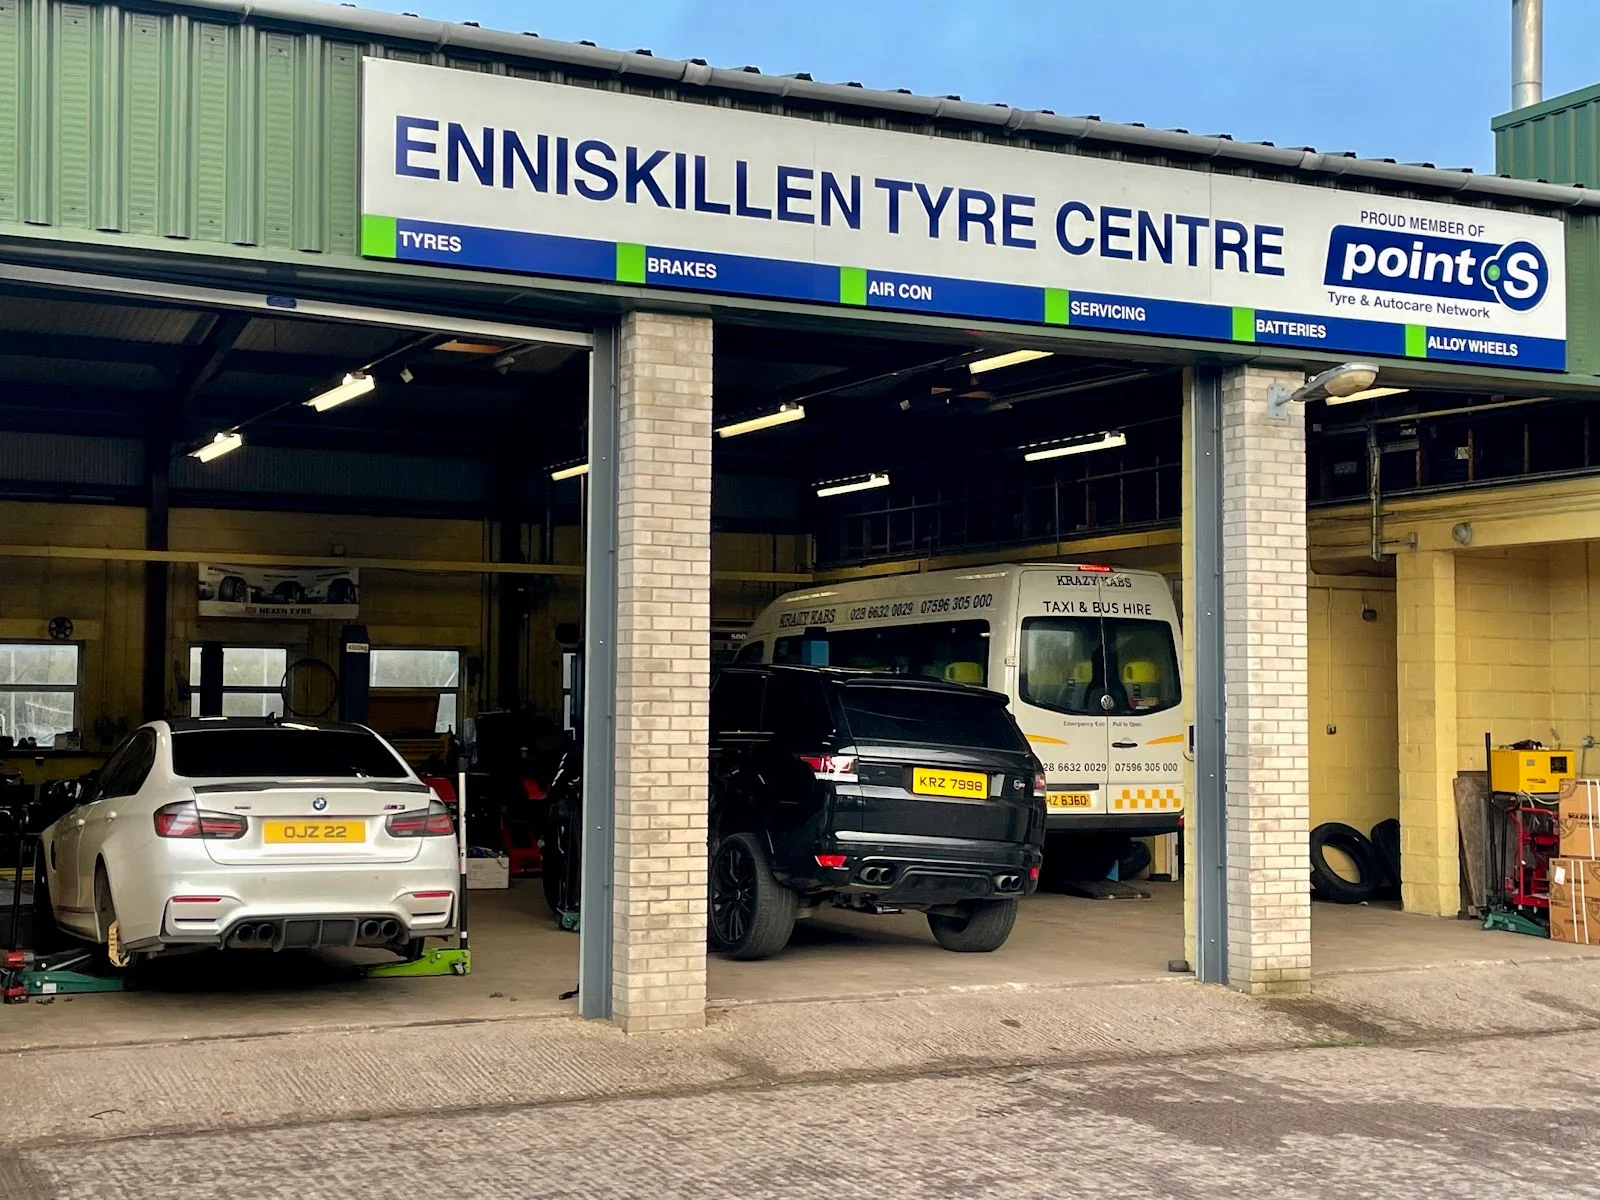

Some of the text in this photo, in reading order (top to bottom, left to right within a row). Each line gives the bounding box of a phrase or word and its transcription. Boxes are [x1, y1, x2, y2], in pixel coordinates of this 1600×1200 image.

[395, 115, 1286, 277] ENNISKILLEN TYRE CENTRE
[1360, 210, 1486, 238] PROUD MEMBER OF
[399, 230, 463, 253] TYRES
[647, 257, 718, 280] BRAKES
[1341, 239, 1540, 299] point S
[868, 280, 933, 301] AIR CON
[1070, 300, 1147, 322] SERVICING
[1327, 291, 1491, 319] Tyre & Autocare Network
[1255, 318, 1328, 339] BATTERIES
[1427, 334, 1519, 358] ALLOY WHEELS
[1056, 575, 1098, 587] KRAZY
[259, 607, 313, 615] NEXEN TYRE
[850, 607, 866, 621] 028
[867, 604, 889, 620] 6632
[891, 601, 913, 617] 0029
[920, 597, 949, 614] 07596
[952, 595, 971, 611] 305
[973, 593, 993, 608] 000
[1043, 601, 1152, 615] TAXI & BUS HIRE
[1042, 762, 1107, 772] 28 6632 0029
[1114, 762, 1178, 772] 07596 305 000
[919, 776, 983, 792] KRZ 7998
[1061, 795, 1087, 806] 6360
[283, 825, 347, 839] OJZ 22
